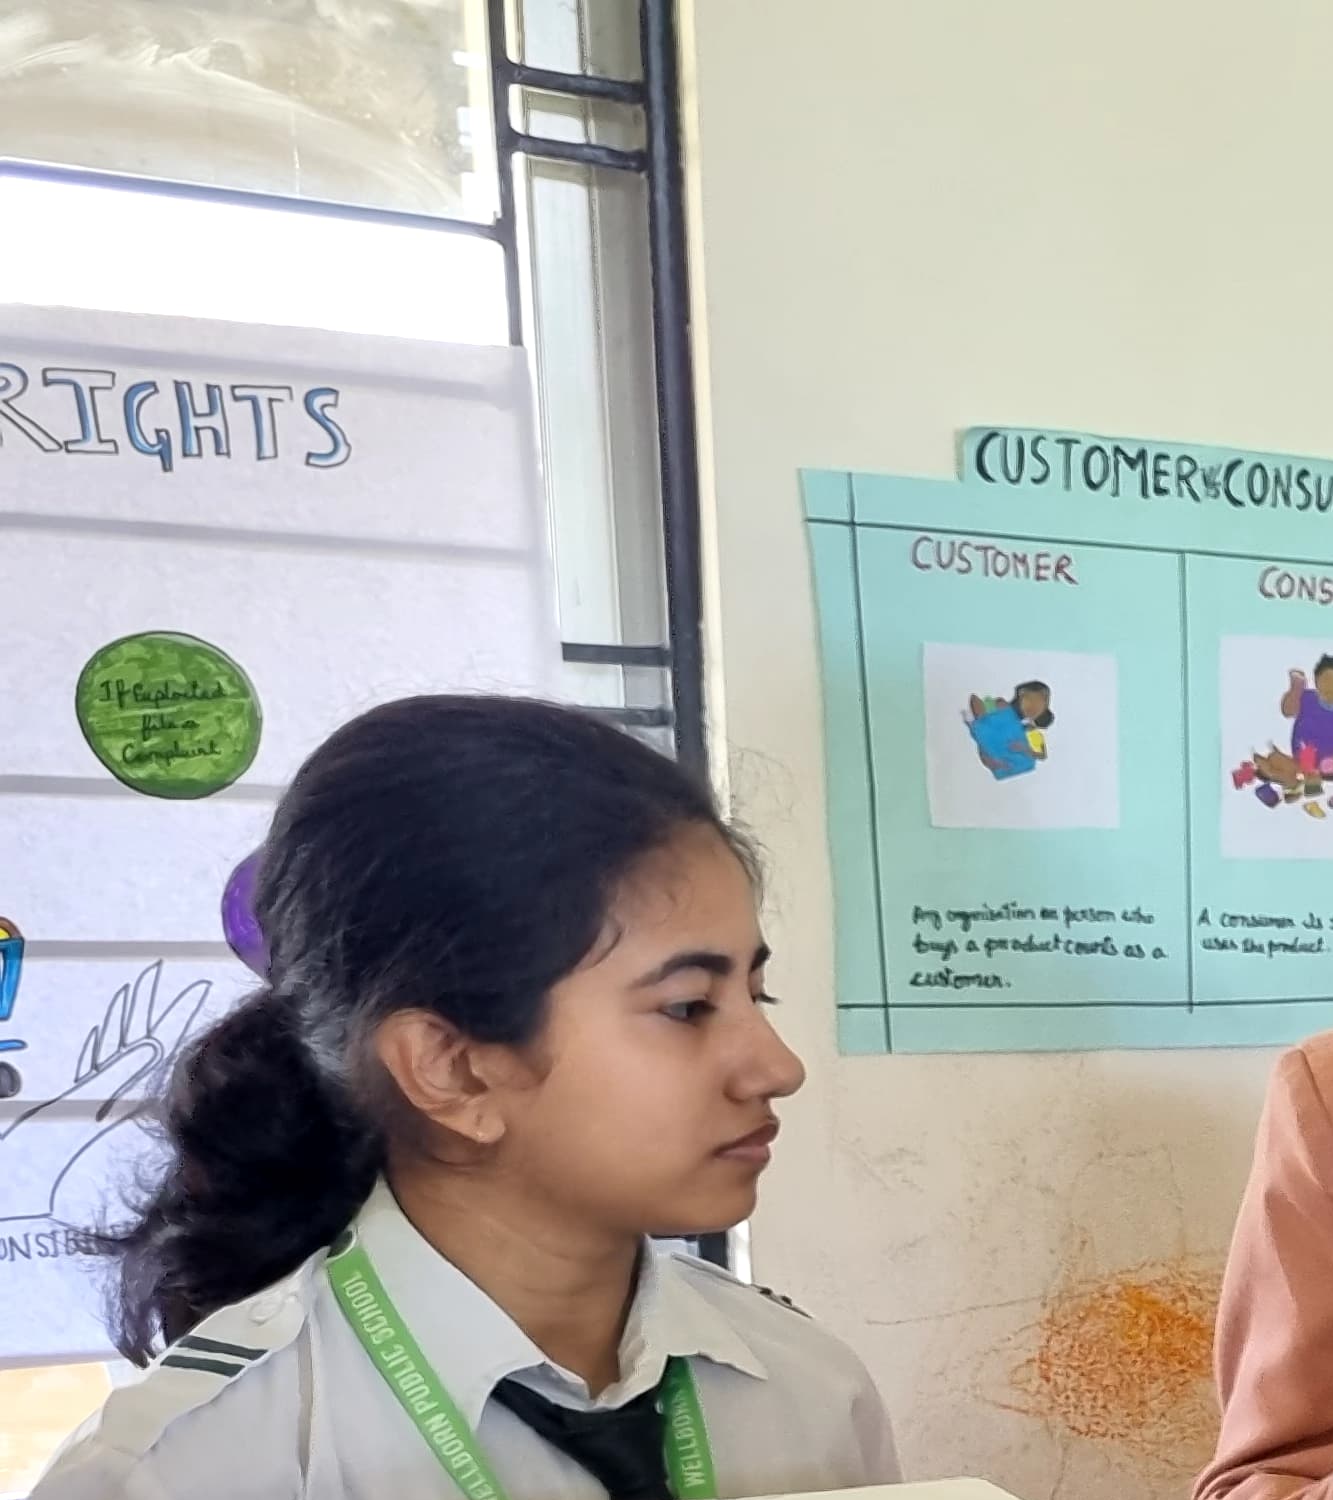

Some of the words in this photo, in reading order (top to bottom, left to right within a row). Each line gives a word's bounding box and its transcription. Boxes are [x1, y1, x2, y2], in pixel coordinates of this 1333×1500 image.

[0, 362, 351, 472] RIGHTS
[974, 430, 1201, 500] CUSTOMER
[909, 535, 1080, 587] CUSTOMER
[1062, 905, 1117, 930] person
[1120, 905, 1156, 925] who
[1196, 906, 1211, 928] A
[965, 939, 981, 954] a
[984, 933, 1062, 960] product
[1122, 943, 1146, 960] as
[1151, 946, 1169, 960] a
[1241, 937, 1267, 955] the
